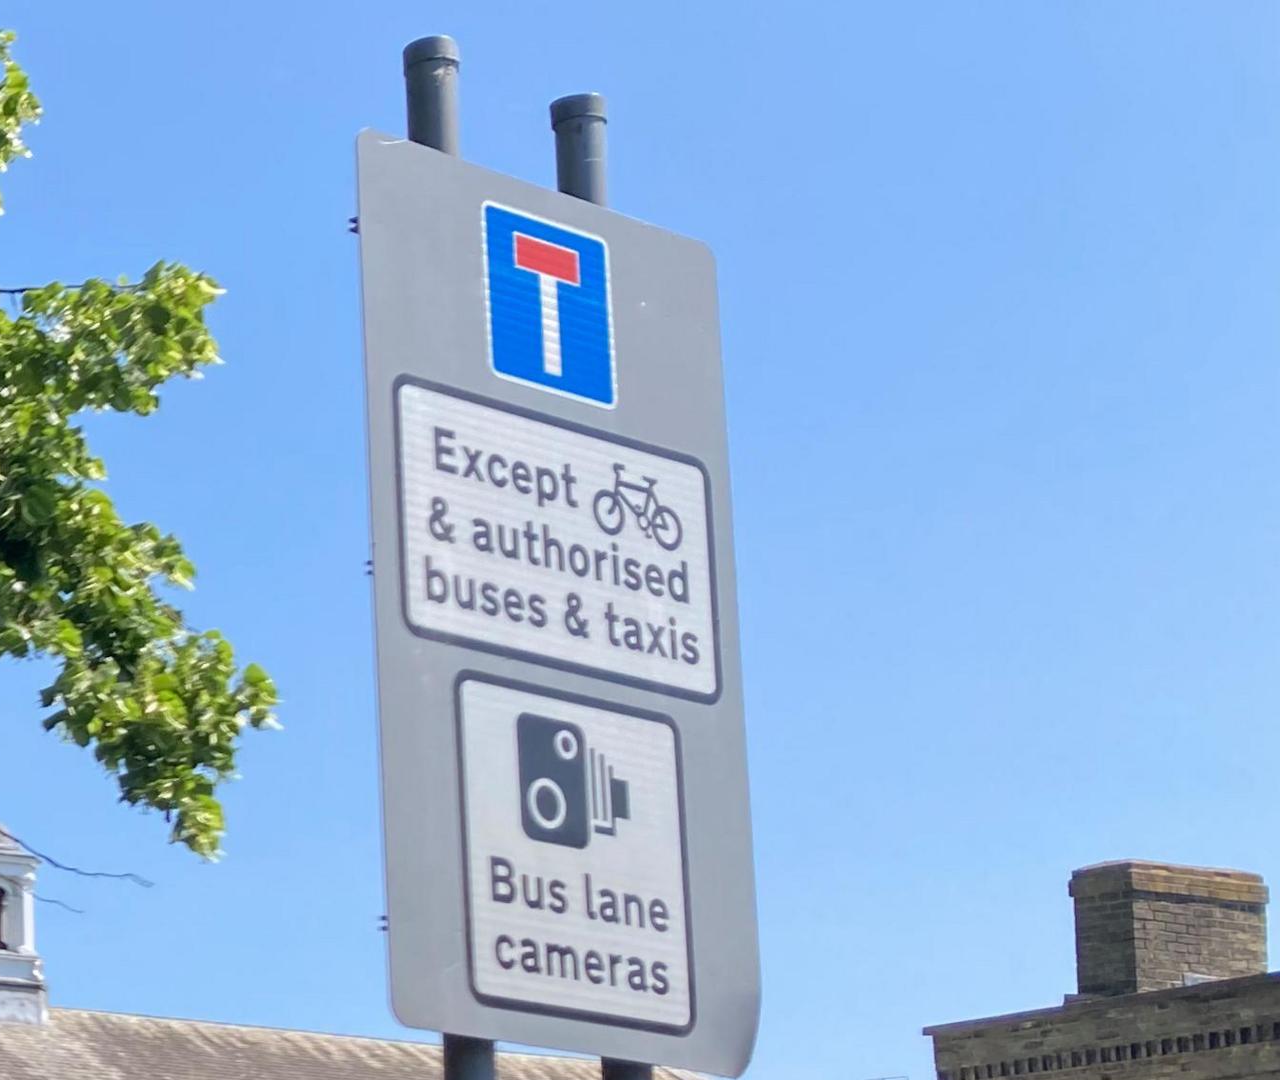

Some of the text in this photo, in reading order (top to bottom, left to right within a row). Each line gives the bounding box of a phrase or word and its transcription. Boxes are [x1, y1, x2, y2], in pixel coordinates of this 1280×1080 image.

[433, 427, 579, 508] Except
[428, 497, 690, 604] & authorised
[425, 555, 701, 666] buses & taxis
[489, 855, 670, 932] Bus lane
[495, 933, 670, 996] cameras
